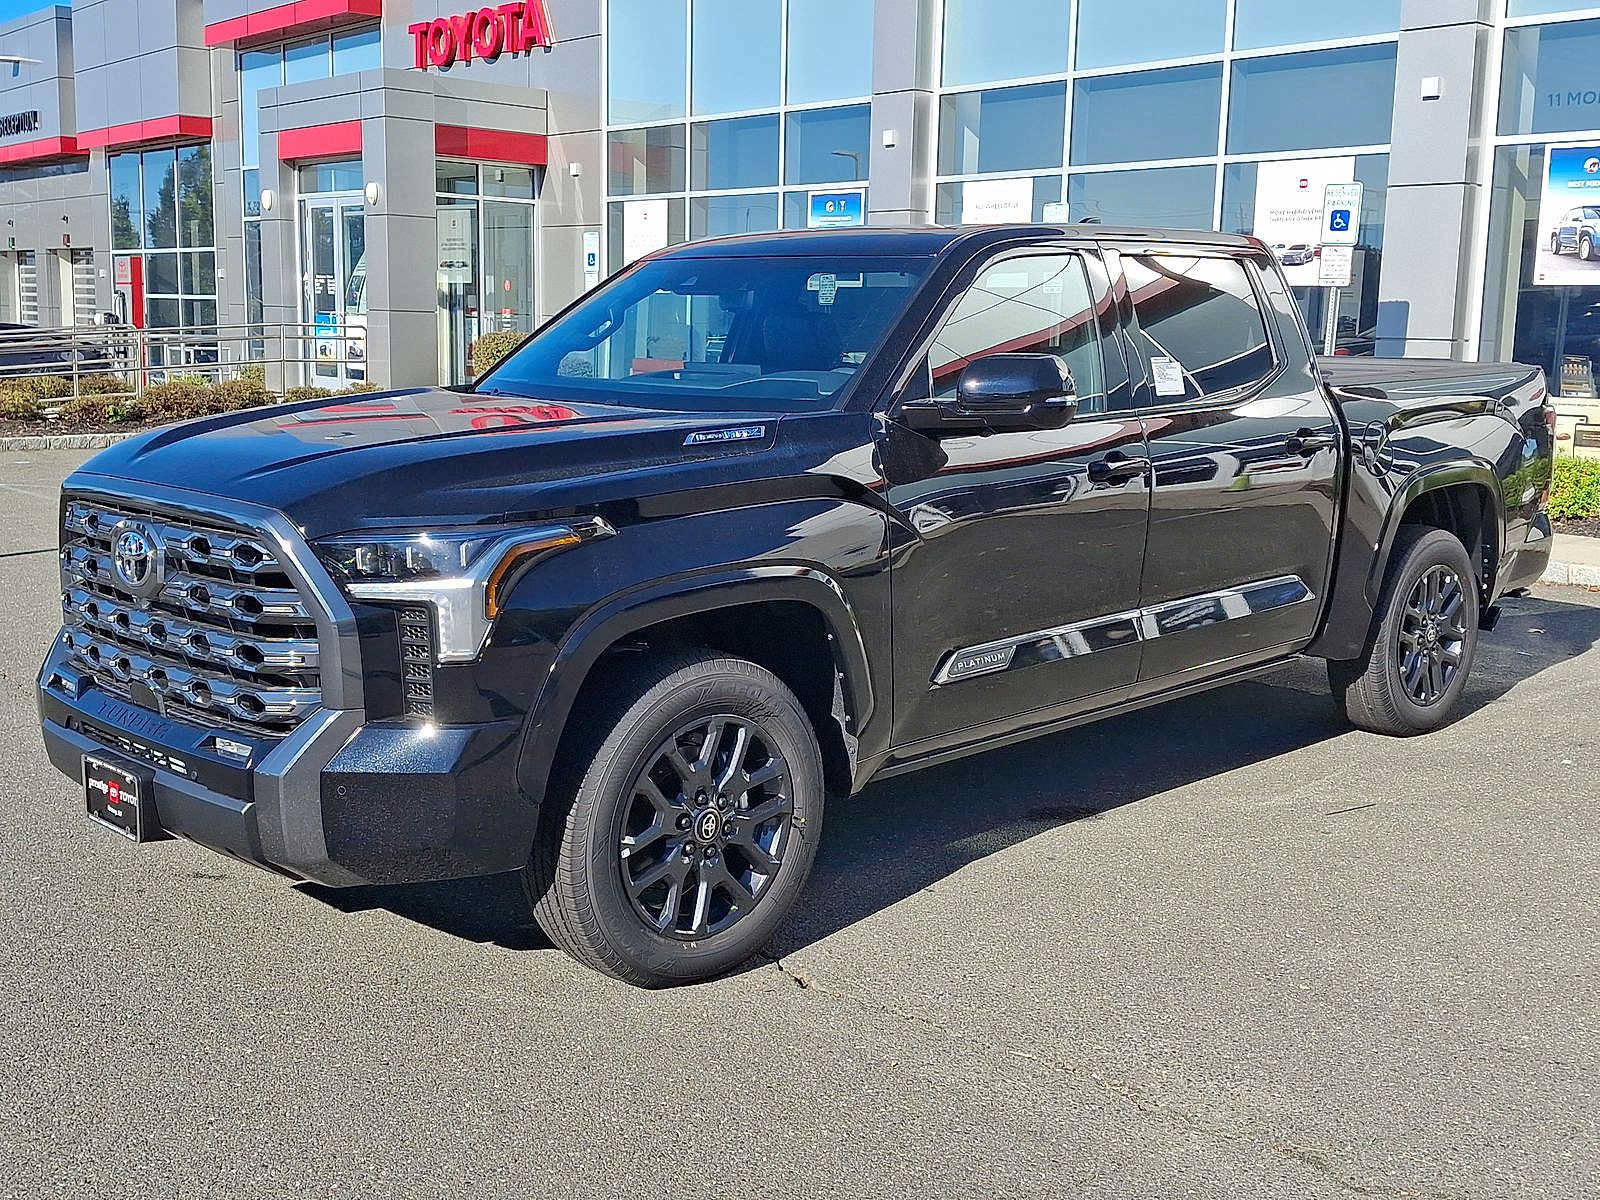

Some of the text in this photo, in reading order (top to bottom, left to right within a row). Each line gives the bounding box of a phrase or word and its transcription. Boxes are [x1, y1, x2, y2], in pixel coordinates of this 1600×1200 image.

[408, 0, 549, 68] TOYOTA
[1567, 91, 1600, 106] MO
[958, 653, 1005, 671] PLATINUM
